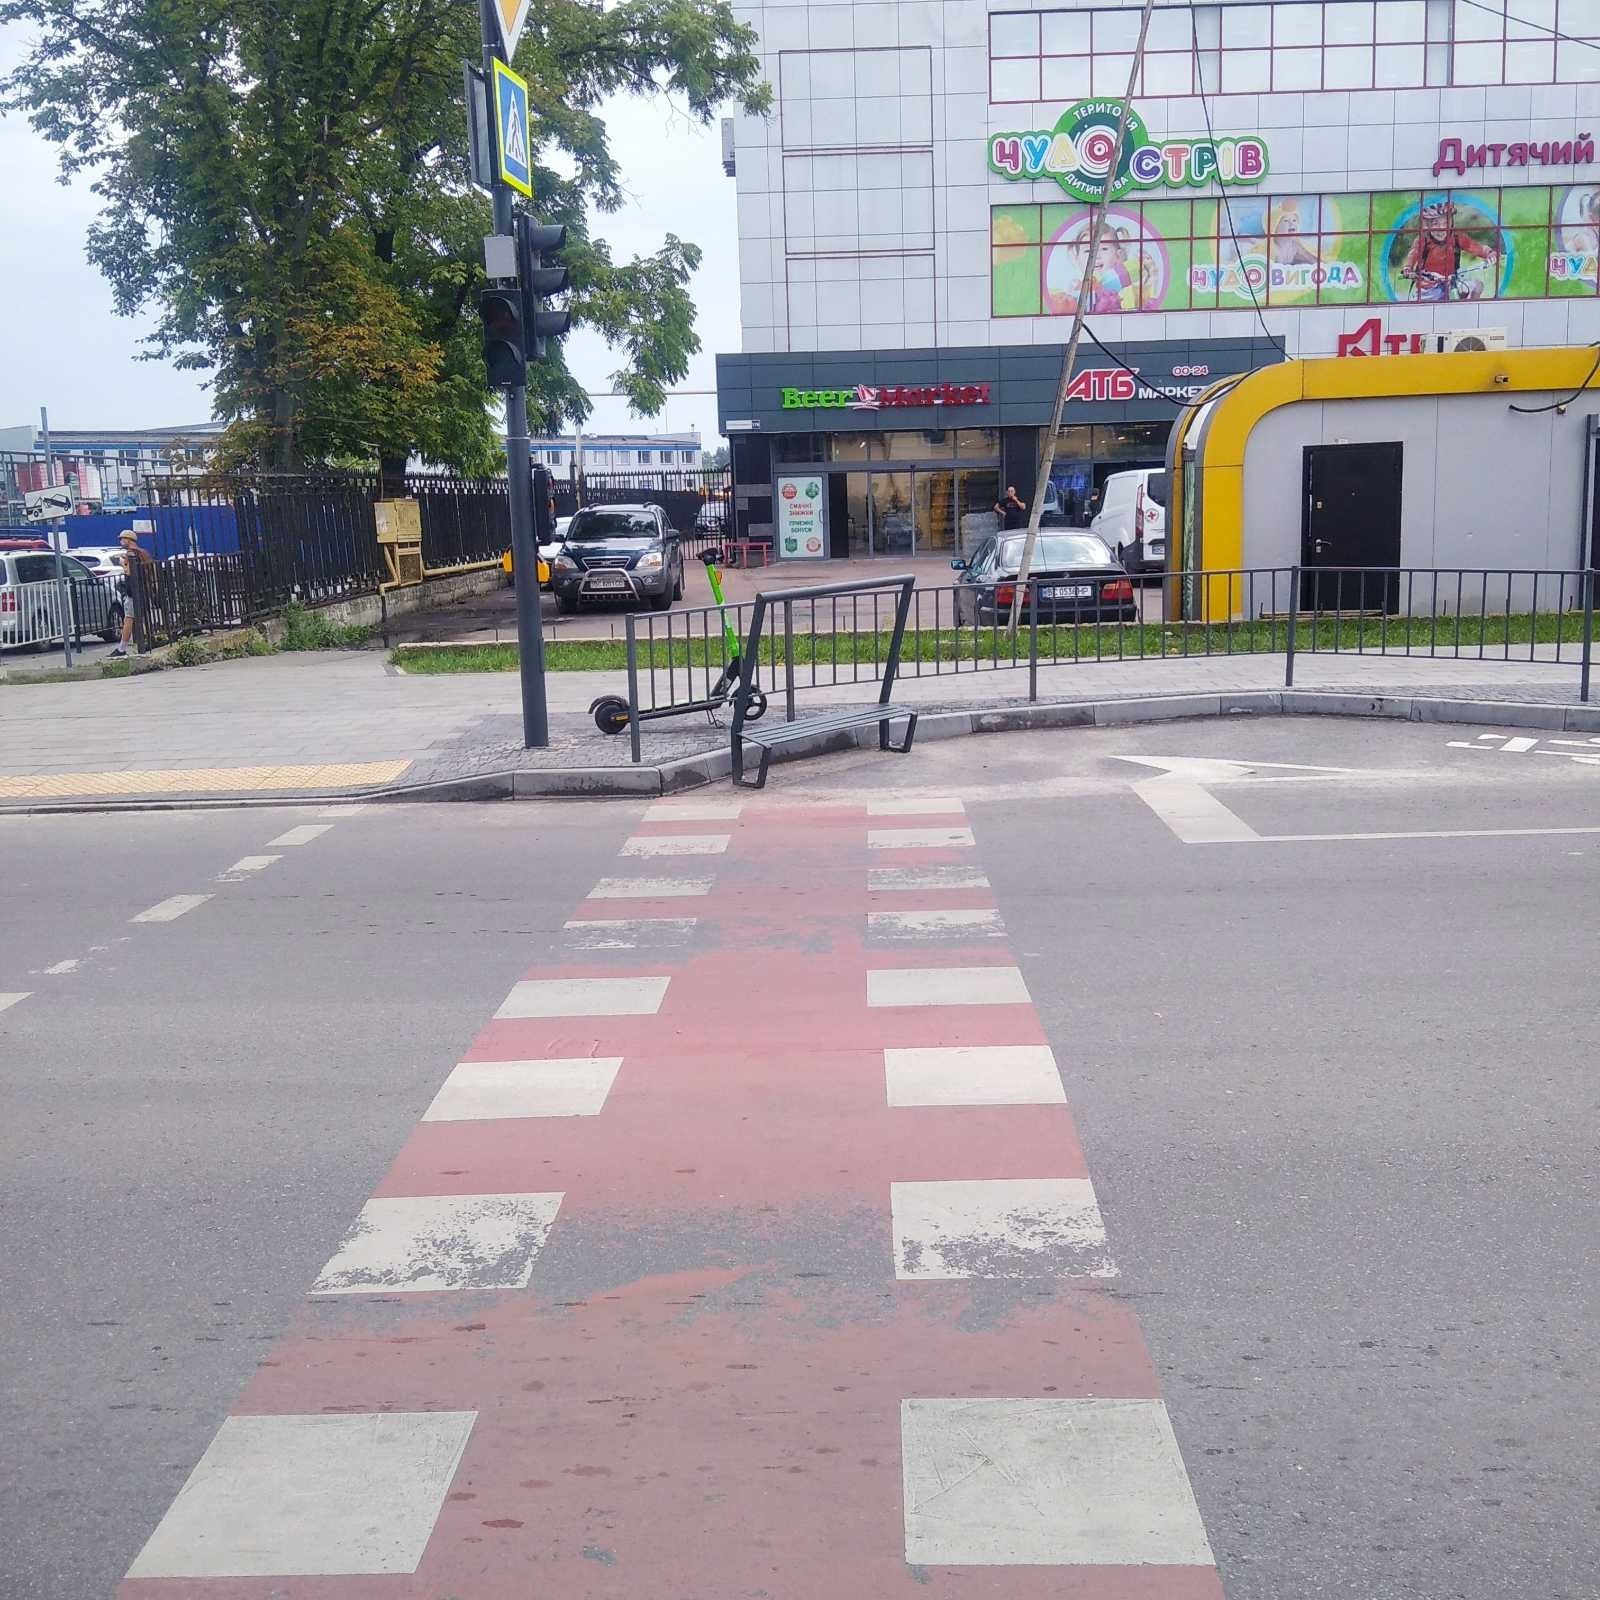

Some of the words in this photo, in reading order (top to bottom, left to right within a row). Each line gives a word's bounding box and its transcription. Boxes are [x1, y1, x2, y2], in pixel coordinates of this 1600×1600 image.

[1073, 103, 1138, 131] ТЕРИТОІЯ
[1433, 132, 1594, 177] Дитячий
[1064, 174, 1129, 195] ДИТИНВА
[782, 388, 852, 408] Beer
[878, 384, 990, 408] Market
[1066, 368, 1139, 401] АТБ
